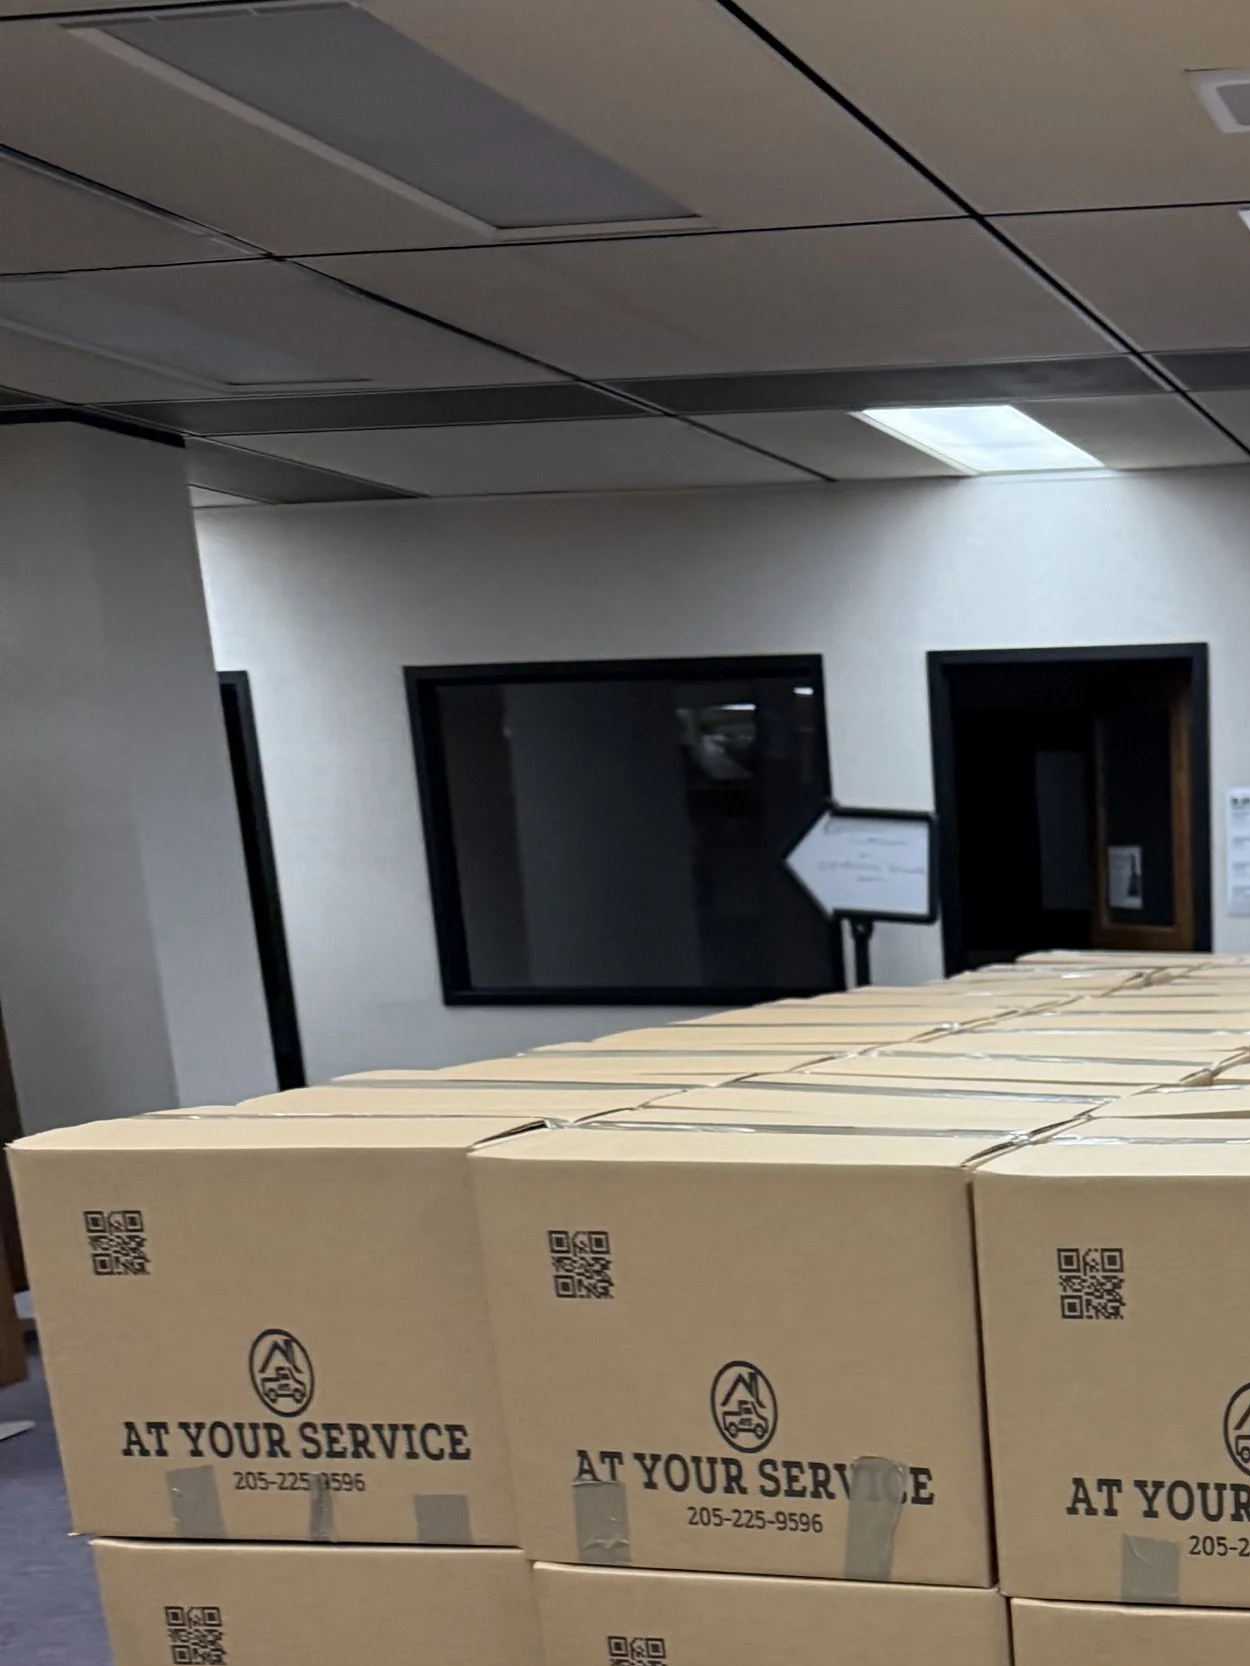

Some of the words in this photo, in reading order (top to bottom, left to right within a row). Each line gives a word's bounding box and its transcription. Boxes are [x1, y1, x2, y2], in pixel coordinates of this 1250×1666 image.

[122, 1421, 169, 1457] AT
[177, 1421, 292, 1459] YOUR
[299, 1422, 472, 1460] SERVICE
[576, 1449, 624, 1482] AT
[633, 1453, 749, 1496] YOUR
[1066, 1477, 1123, 1516] AT
[687, 1506, 824, 1533] 205-225-9596
